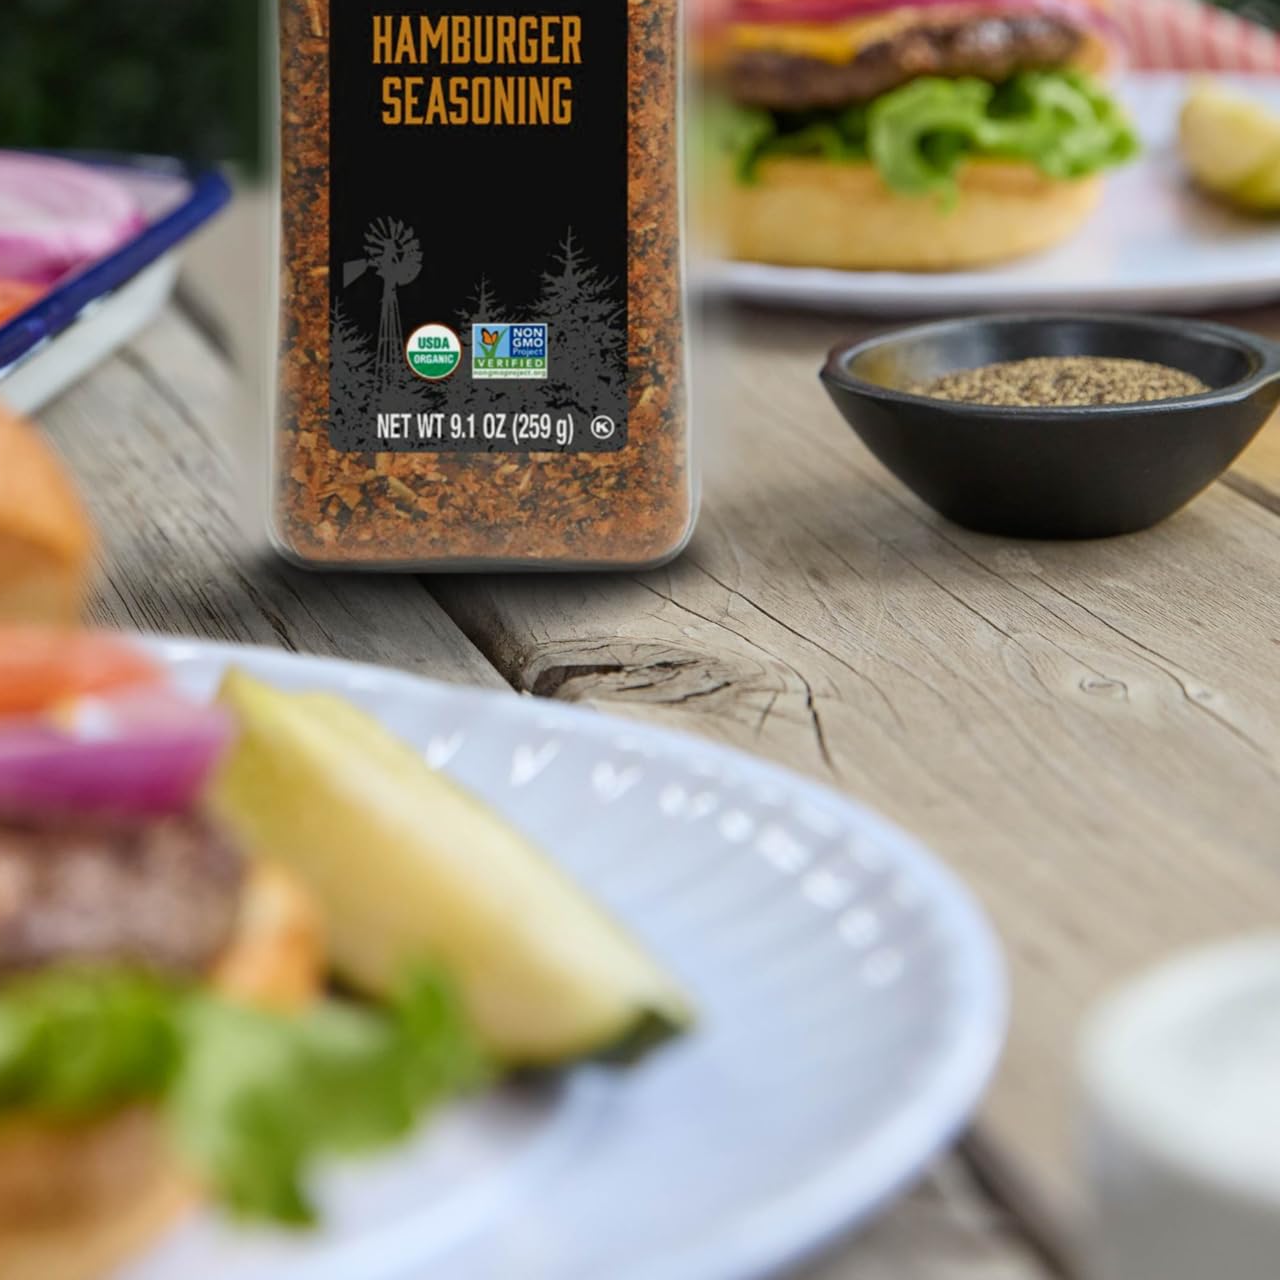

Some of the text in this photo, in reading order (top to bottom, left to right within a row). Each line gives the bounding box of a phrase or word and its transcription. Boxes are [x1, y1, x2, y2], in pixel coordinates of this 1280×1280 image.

[372, 15, 582, 64] HAMBURGER
[382, 76, 572, 125] SEASONING
[513, 328, 543, 337] NON
[417, 336, 450, 350] USDA
[512, 338, 544, 348] GMO
[513, 348, 543, 357] Project
[413, 354, 454, 365] ORGANIC
[477, 358, 543, 368] VERIFIED
[377, 412, 574, 444] NET WT 9.1 OZ (259 g)
